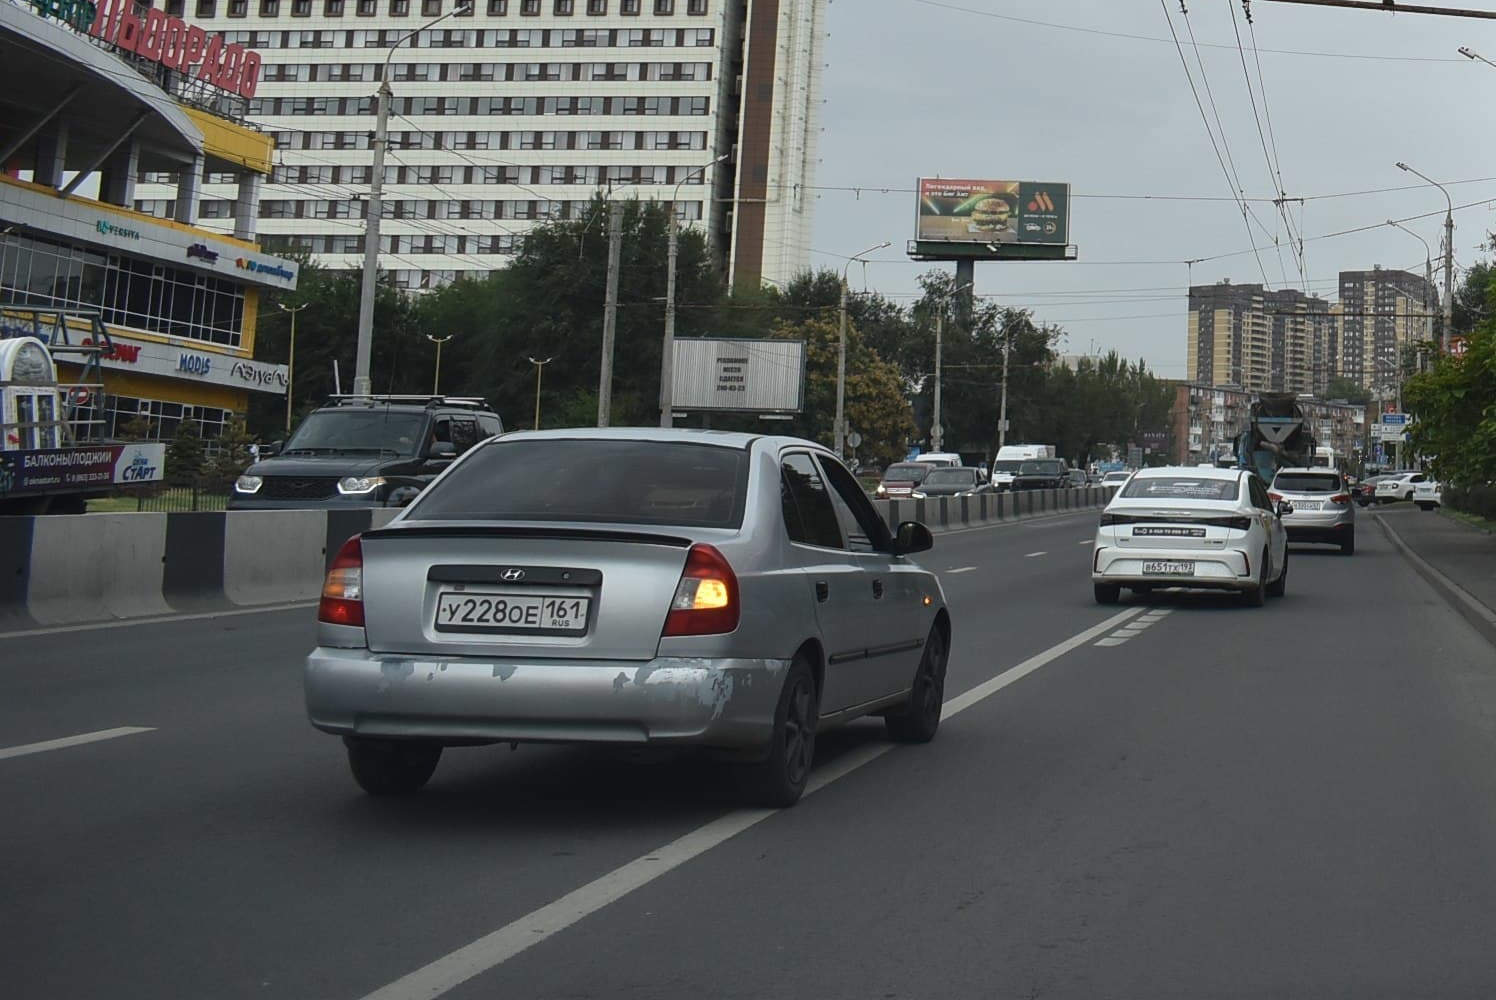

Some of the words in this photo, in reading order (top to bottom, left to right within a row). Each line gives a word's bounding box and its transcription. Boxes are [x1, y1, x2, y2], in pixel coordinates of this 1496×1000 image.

[179, 353, 211, 374] MODIS
[24, 452, 112, 469] БАЛКОНЫ/ЛОДЖИИ
[448, 599, 539, 625] У228ОЕ
[546, 600, 581, 619] 161
[551, 619, 571, 627] RUS
